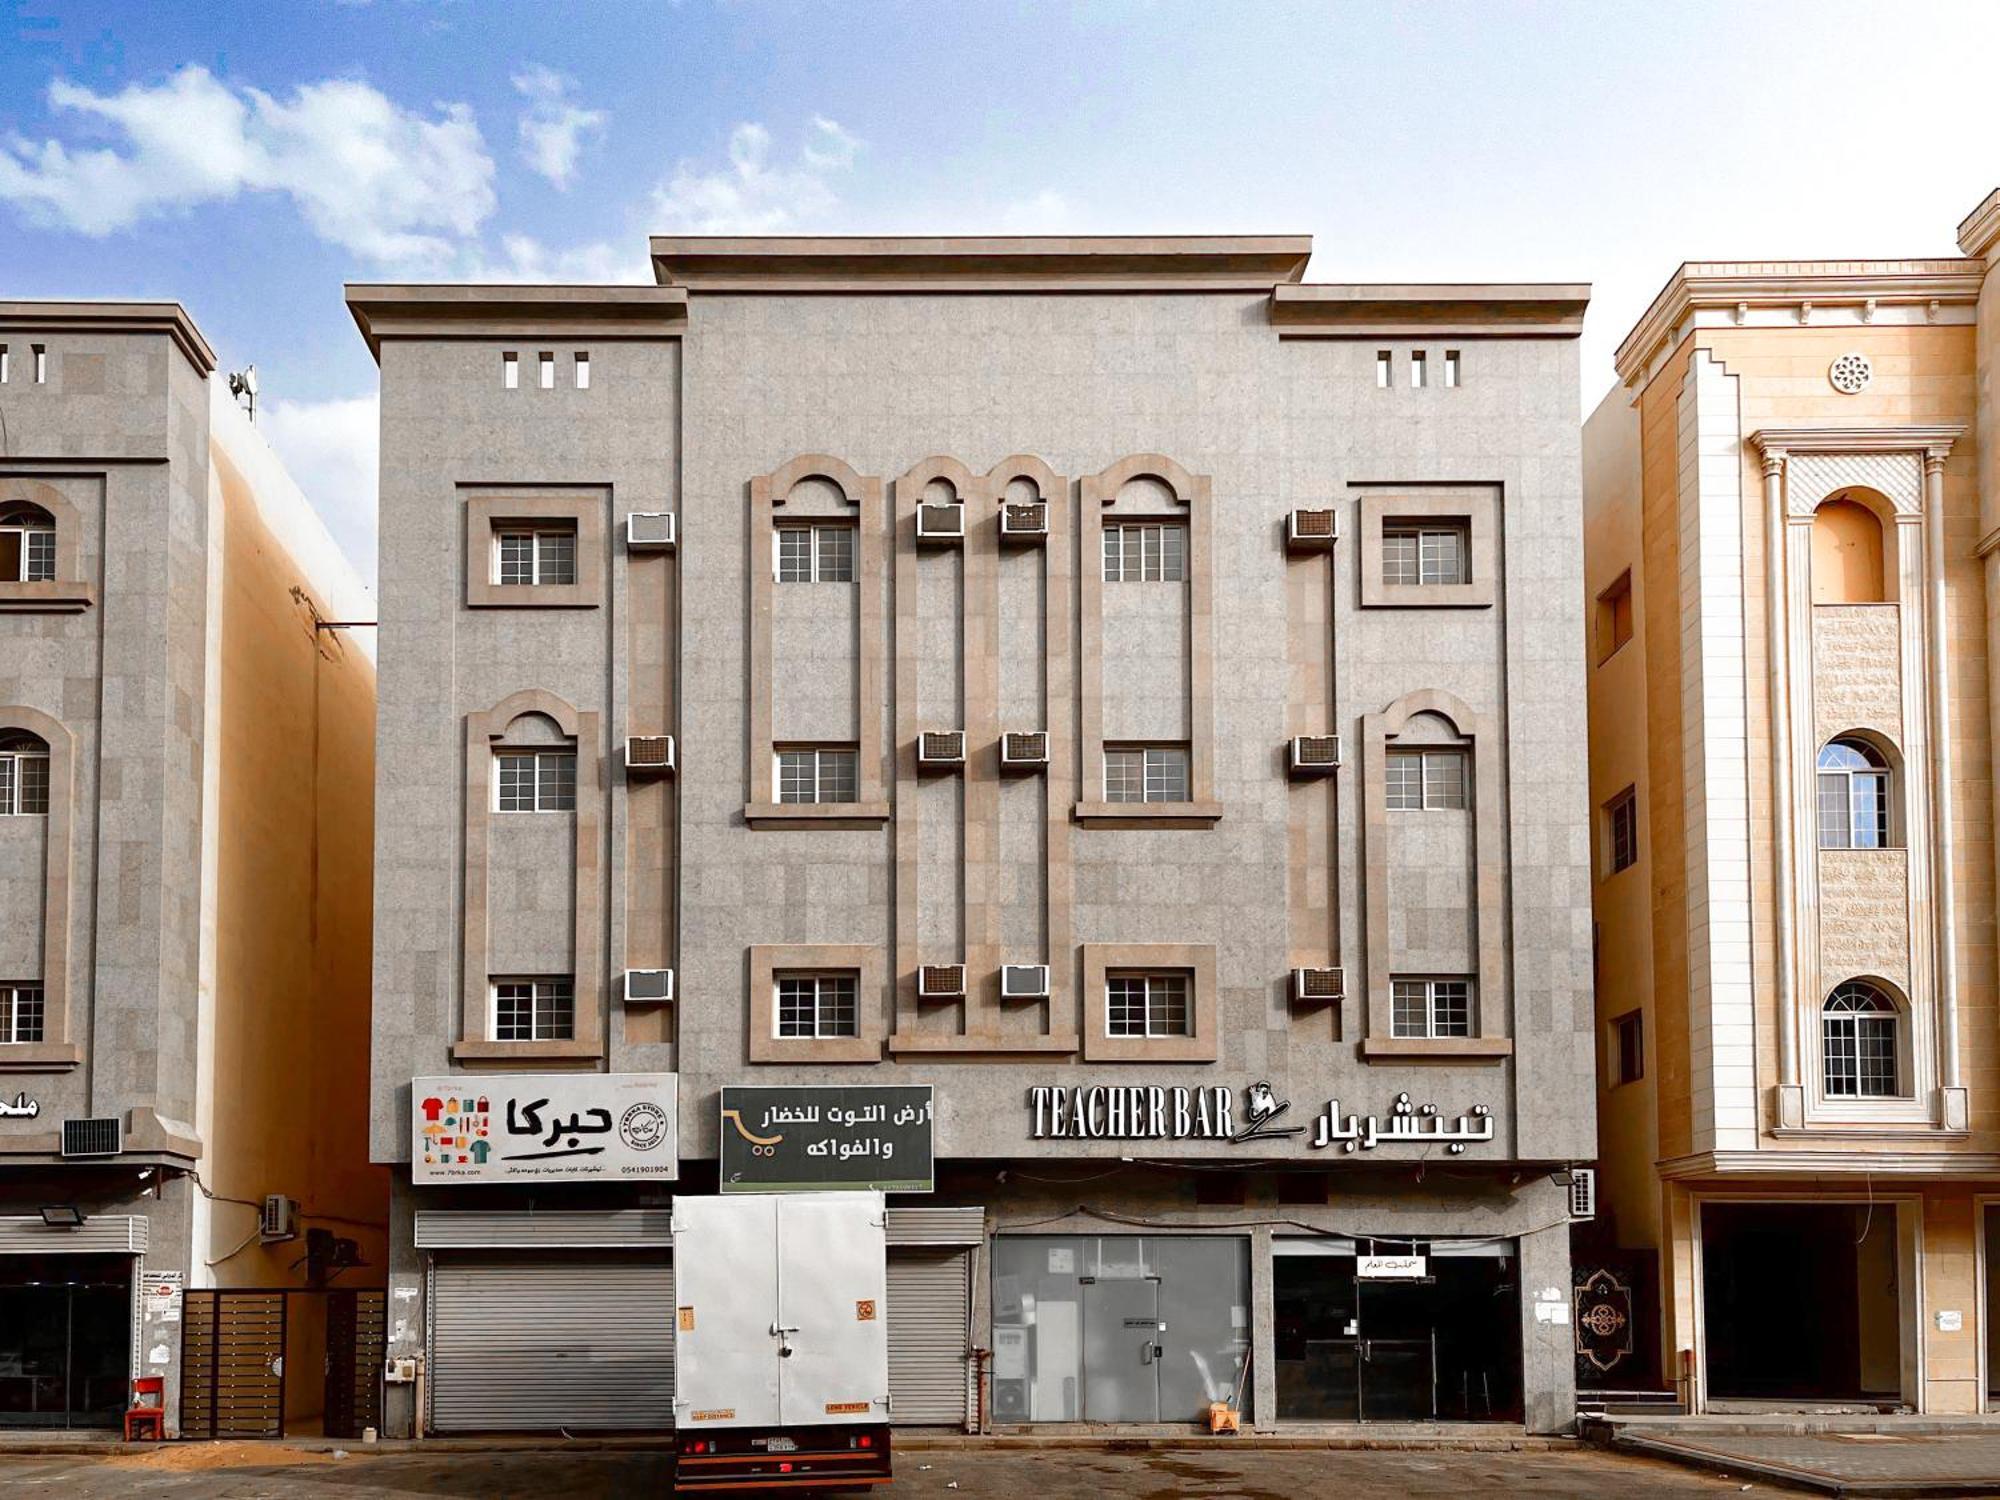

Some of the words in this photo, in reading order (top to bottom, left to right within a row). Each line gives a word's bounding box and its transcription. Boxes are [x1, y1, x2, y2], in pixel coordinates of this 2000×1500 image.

[506, 1098, 613, 1148] حبركا
[761, 1105, 820, 1127] للخضار
[827, 1105, 886, 1127] التوت
[893, 1100, 932, 1126] أرض
[807, 1138, 893, 1160] والفواكه
